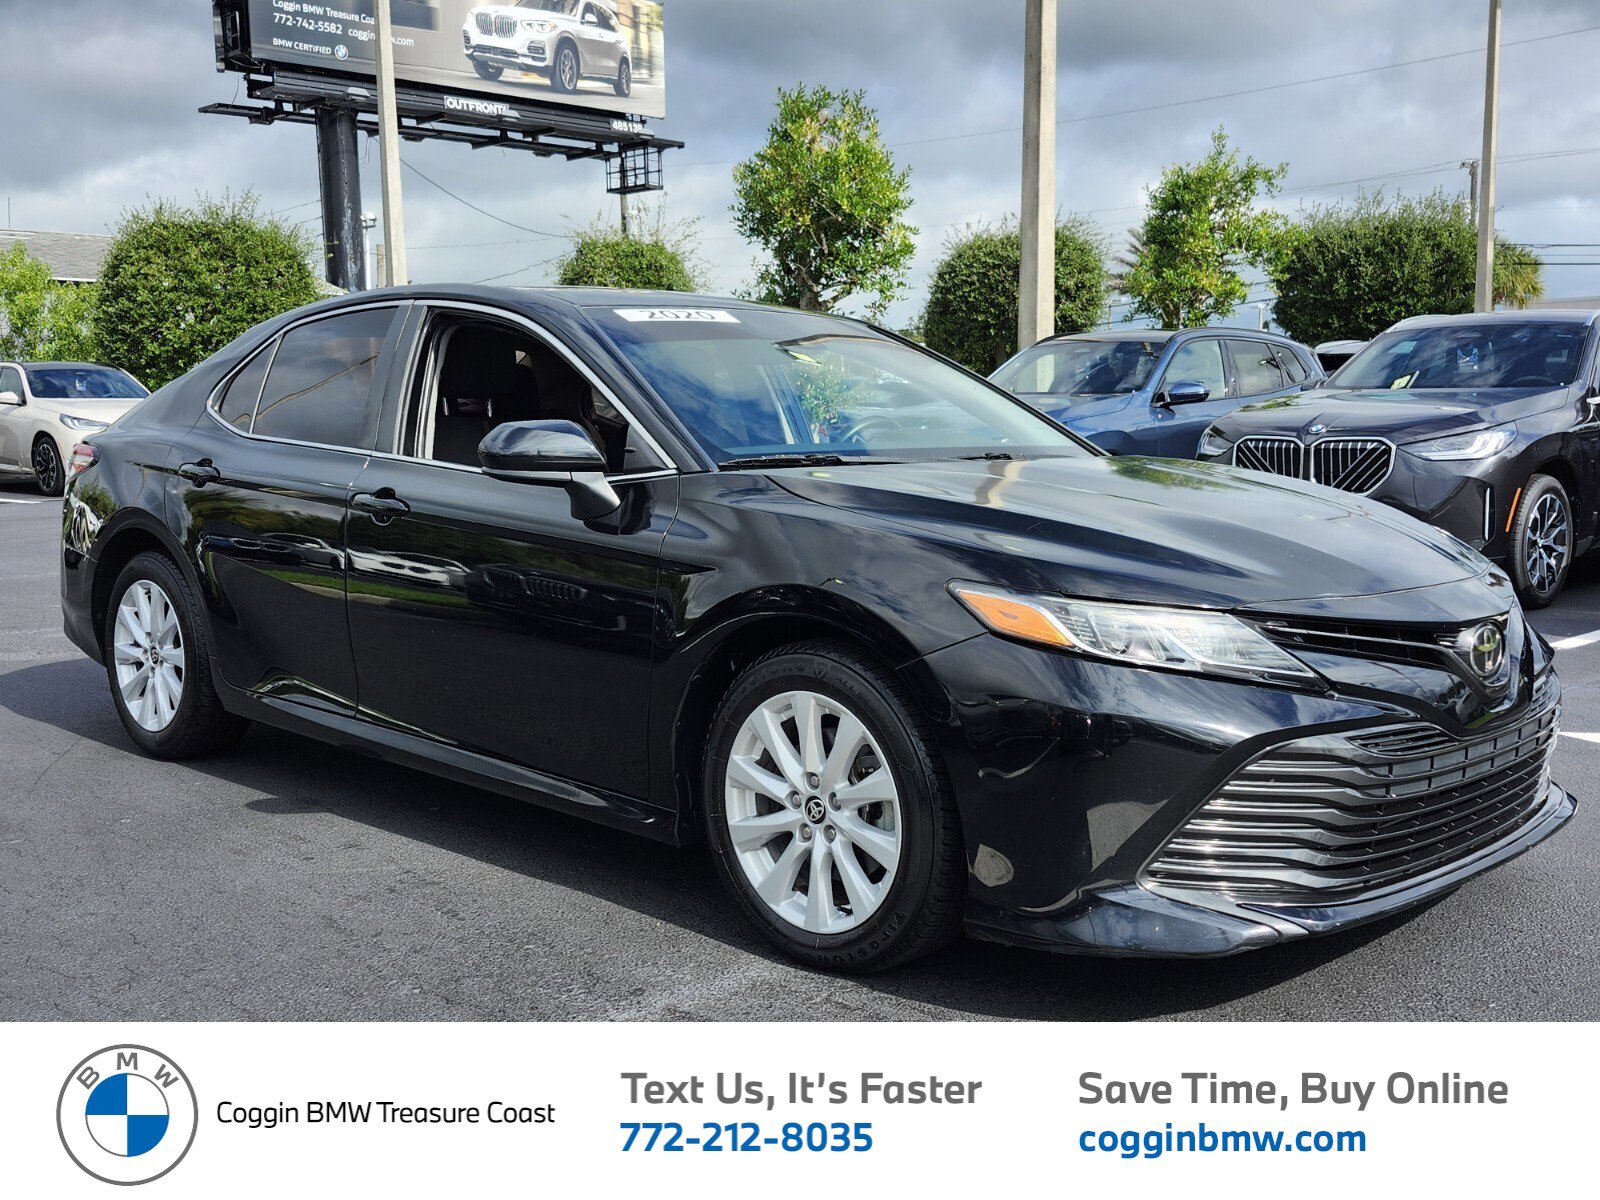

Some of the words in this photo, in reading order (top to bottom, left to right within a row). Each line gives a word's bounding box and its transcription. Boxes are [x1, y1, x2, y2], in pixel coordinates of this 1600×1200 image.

[273, 0, 301, 12] Coggin
[303, 4, 324, 16] BMW
[325, 8, 359, 22] Treasure
[361, 14, 375, 25] Coa
[273, 13, 343, 35] 772-742-5582
[272, 37, 293, 48] BMW
[294, 42, 332, 55] CERTIFIED
[638, 310, 717, 320] 2020
